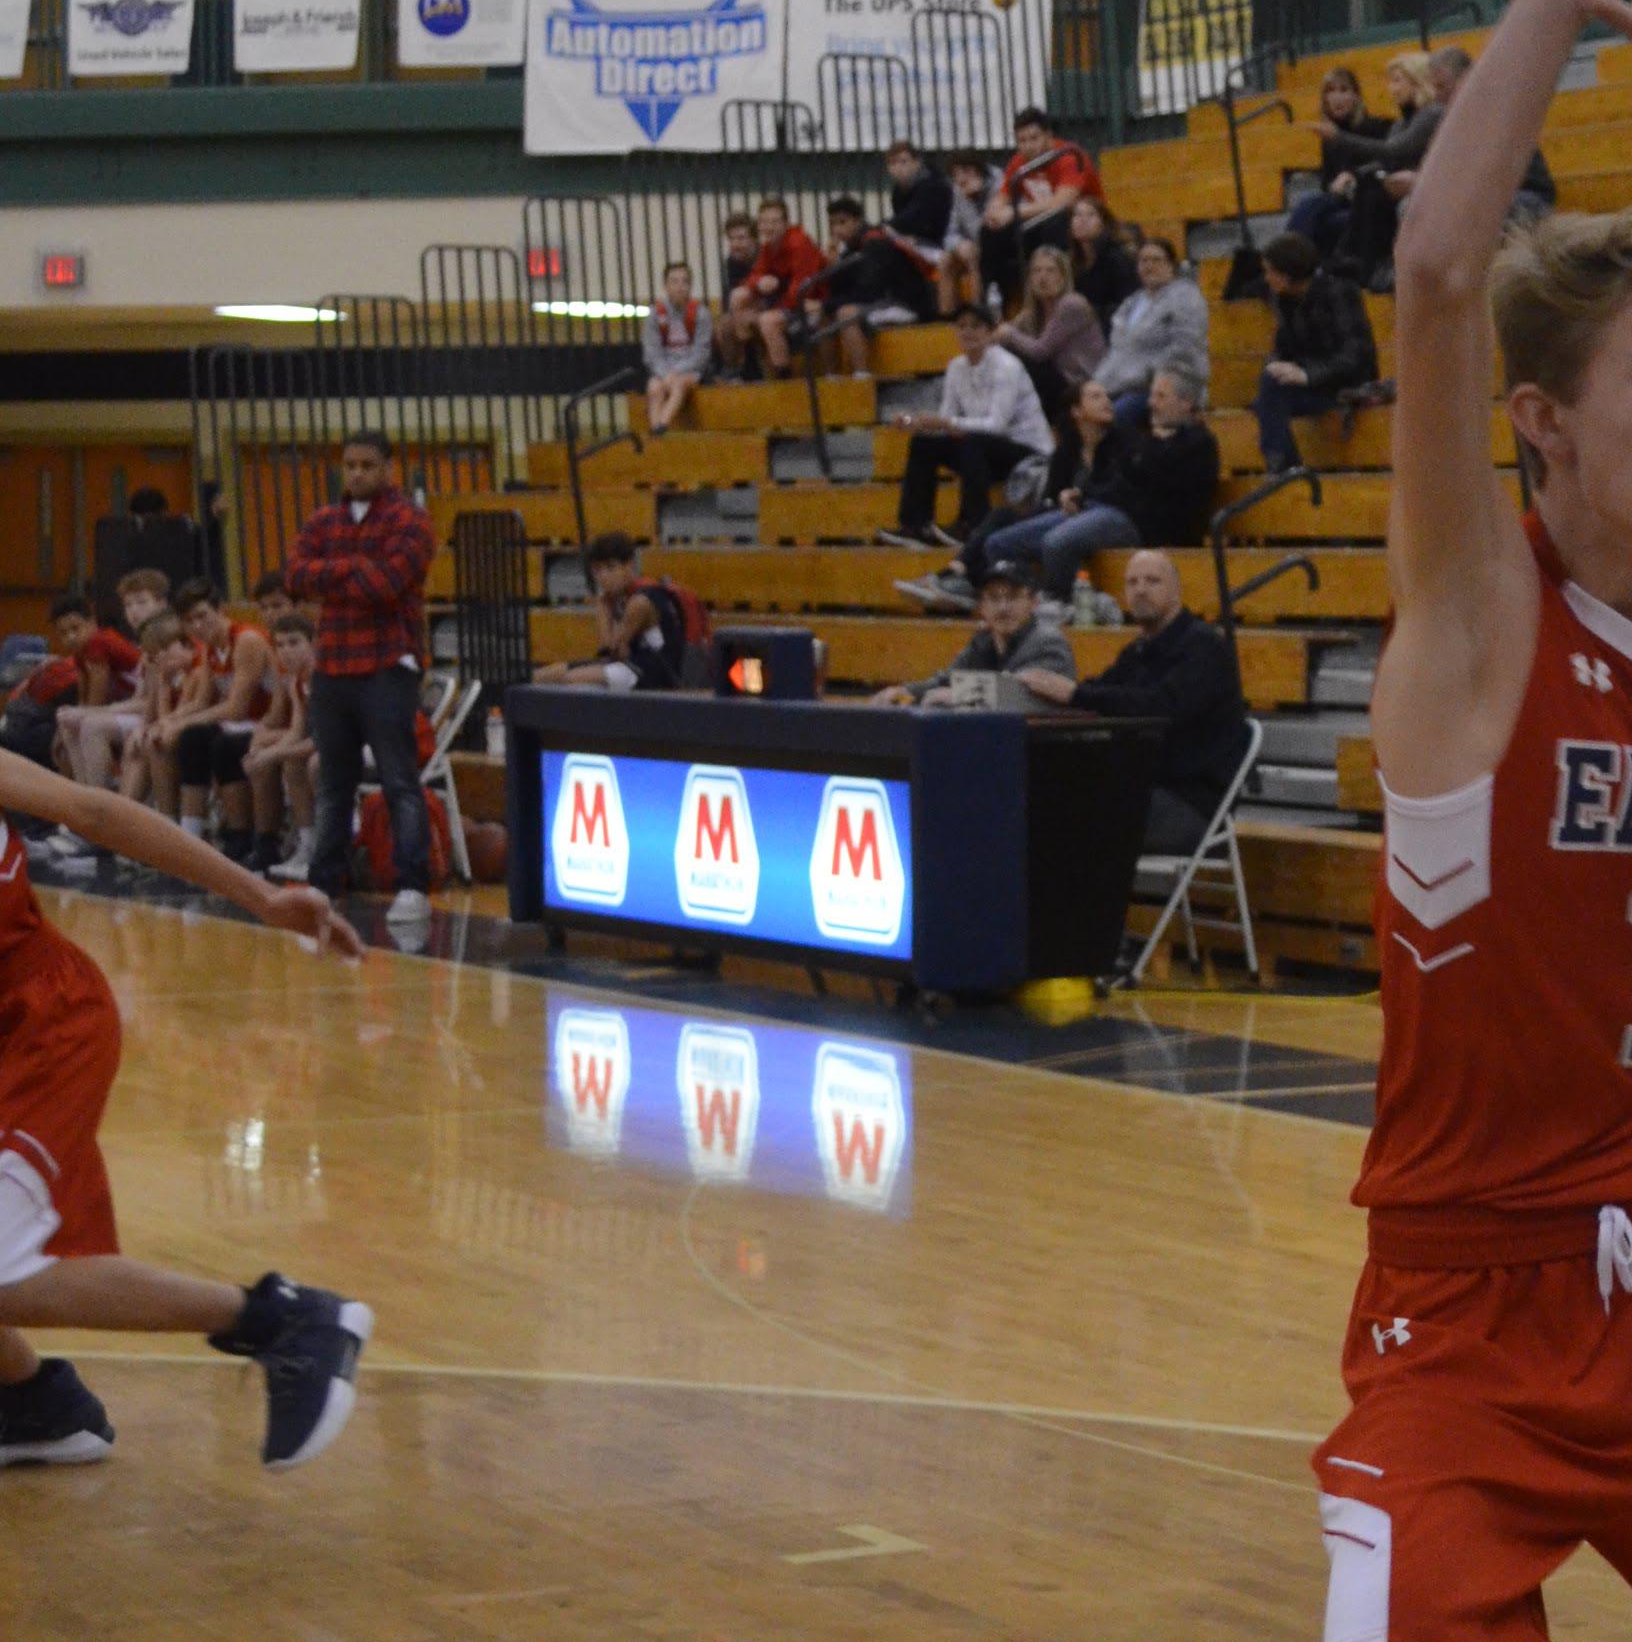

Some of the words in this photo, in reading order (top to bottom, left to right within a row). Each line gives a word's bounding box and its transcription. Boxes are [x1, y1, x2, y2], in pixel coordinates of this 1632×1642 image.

[550, 13, 764, 59] Automation
[601, 57, 714, 95] Direct
[570, 780, 611, 848] M
[694, 792, 740, 864] M
[831, 806, 883, 882] M
